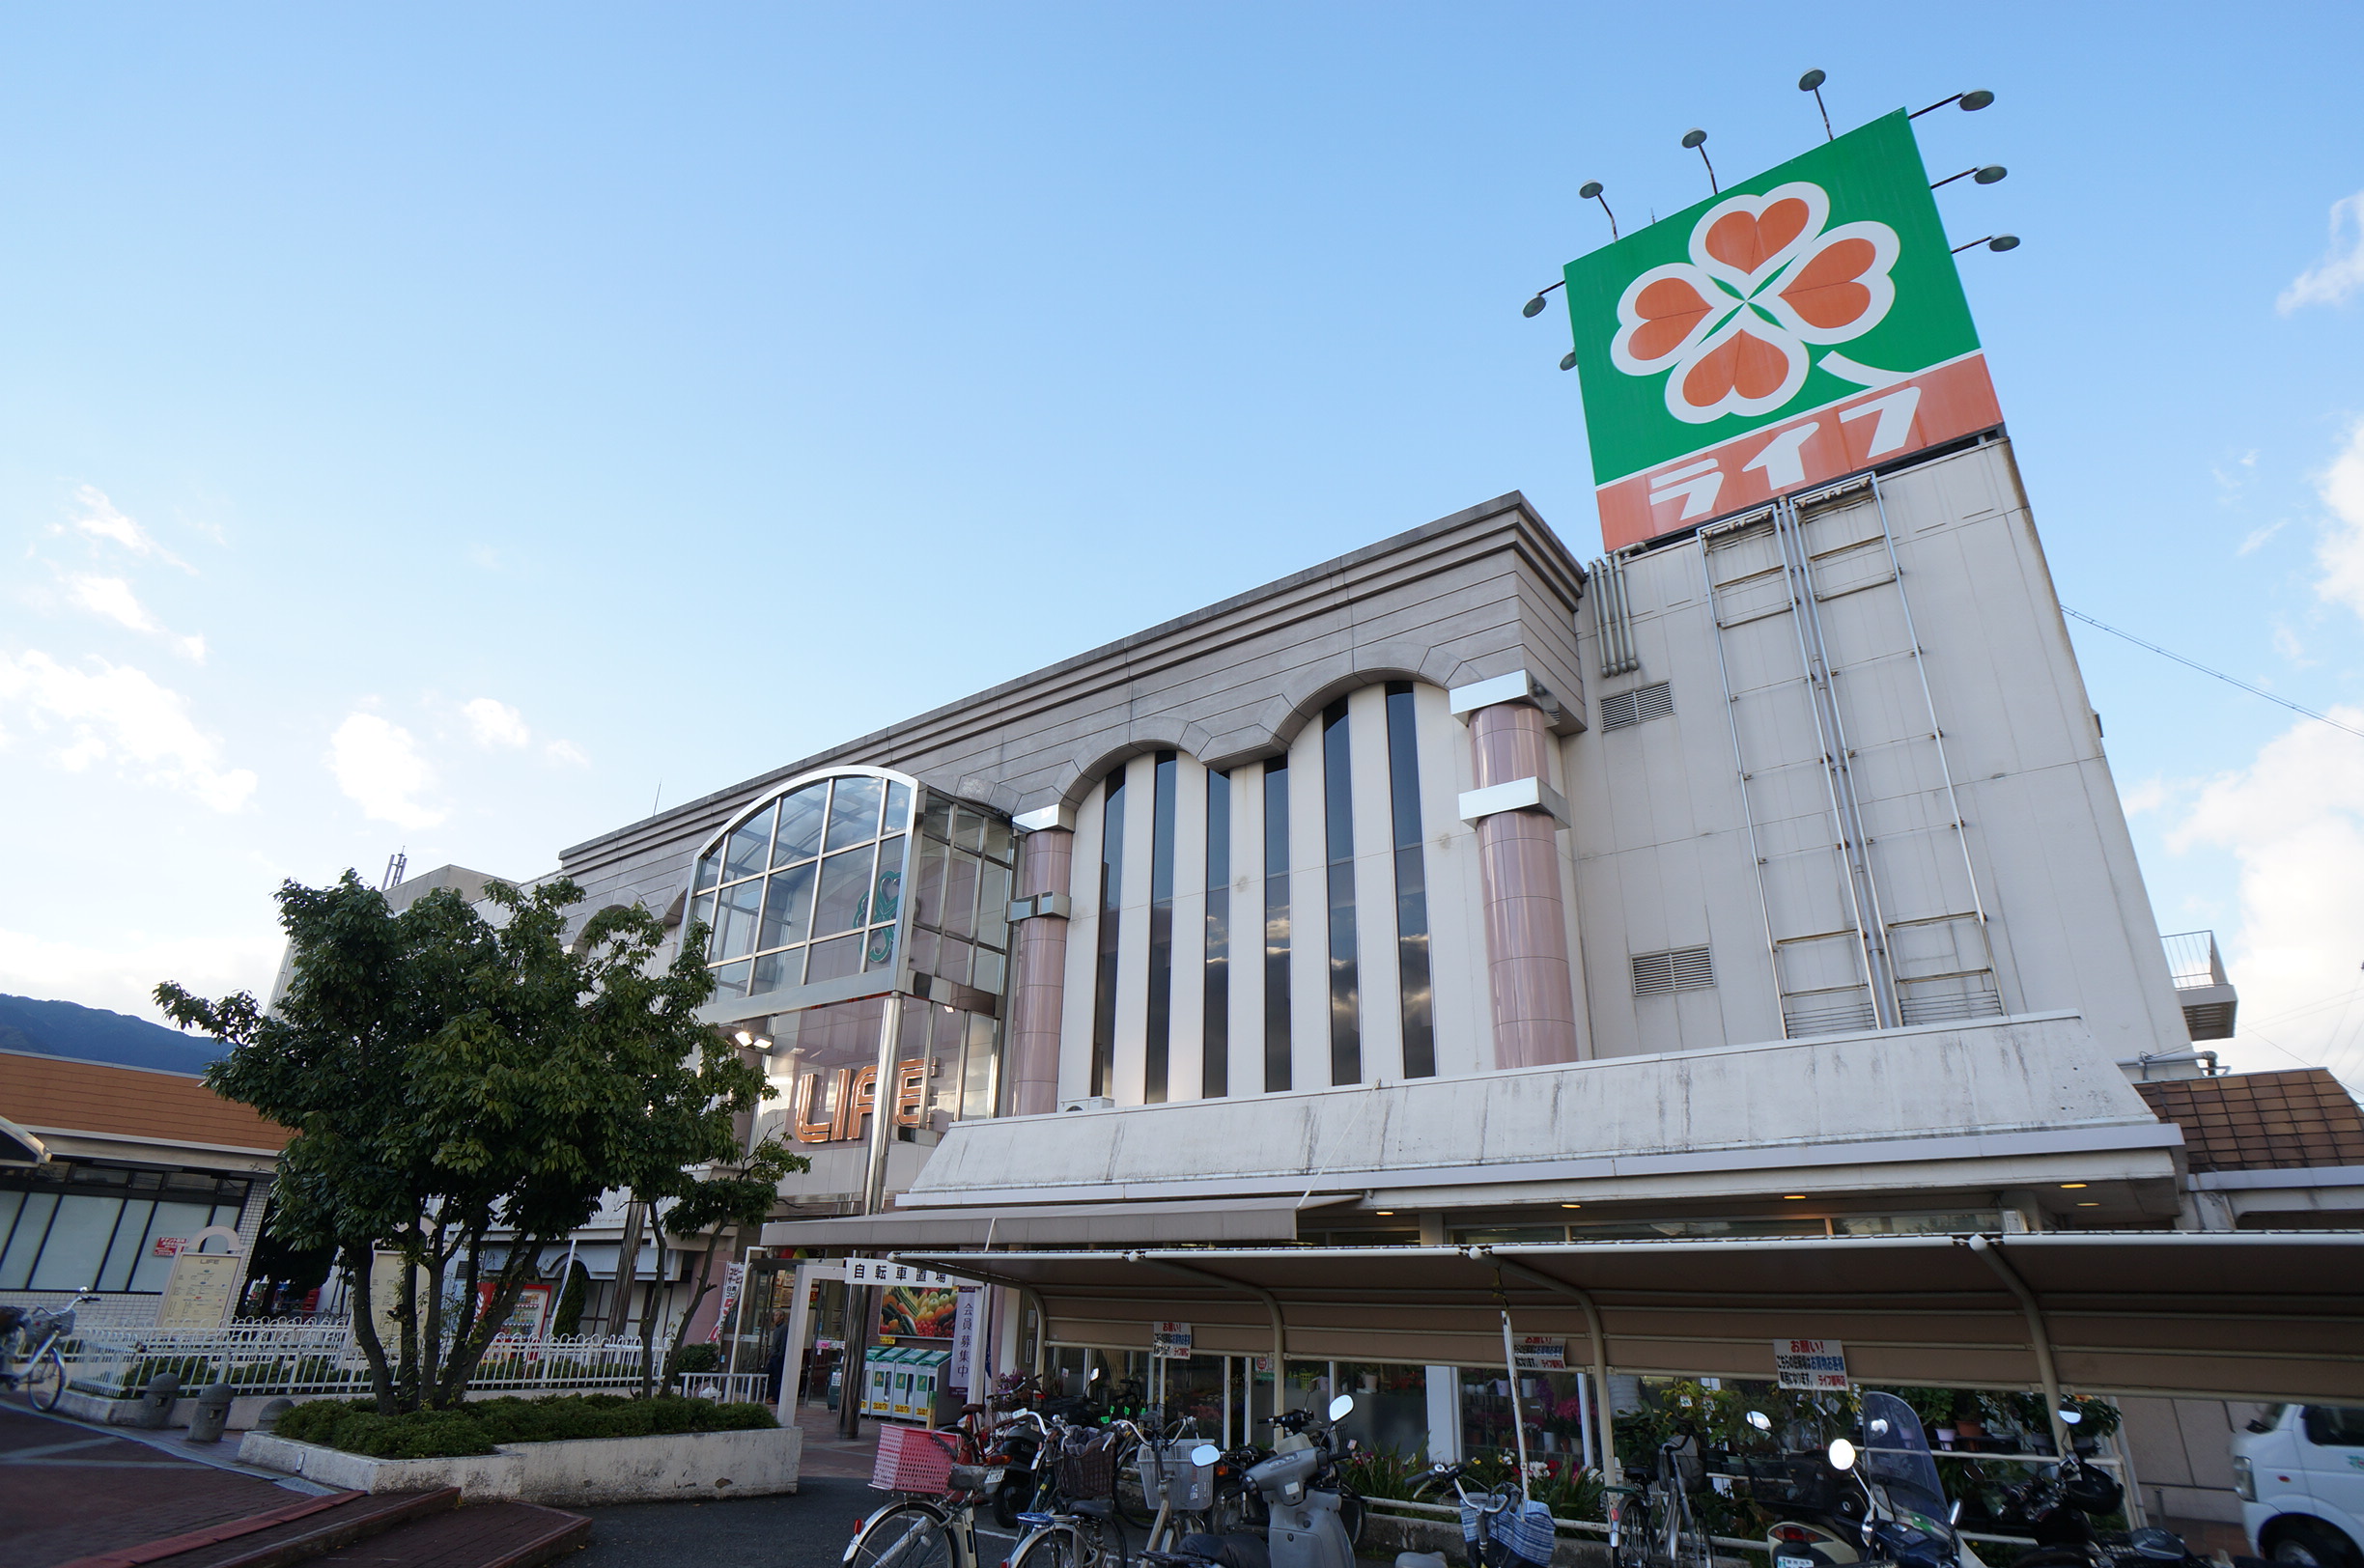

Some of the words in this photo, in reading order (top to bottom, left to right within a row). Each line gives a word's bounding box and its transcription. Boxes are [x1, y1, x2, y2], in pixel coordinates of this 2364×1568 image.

[1649, 386, 1922, 521] ライフ
[796, 1056, 940, 1143] LIFE
[854, 1264, 946, 1283] 自転車置場
[958, 1303, 973, 1378] 会員募集中
